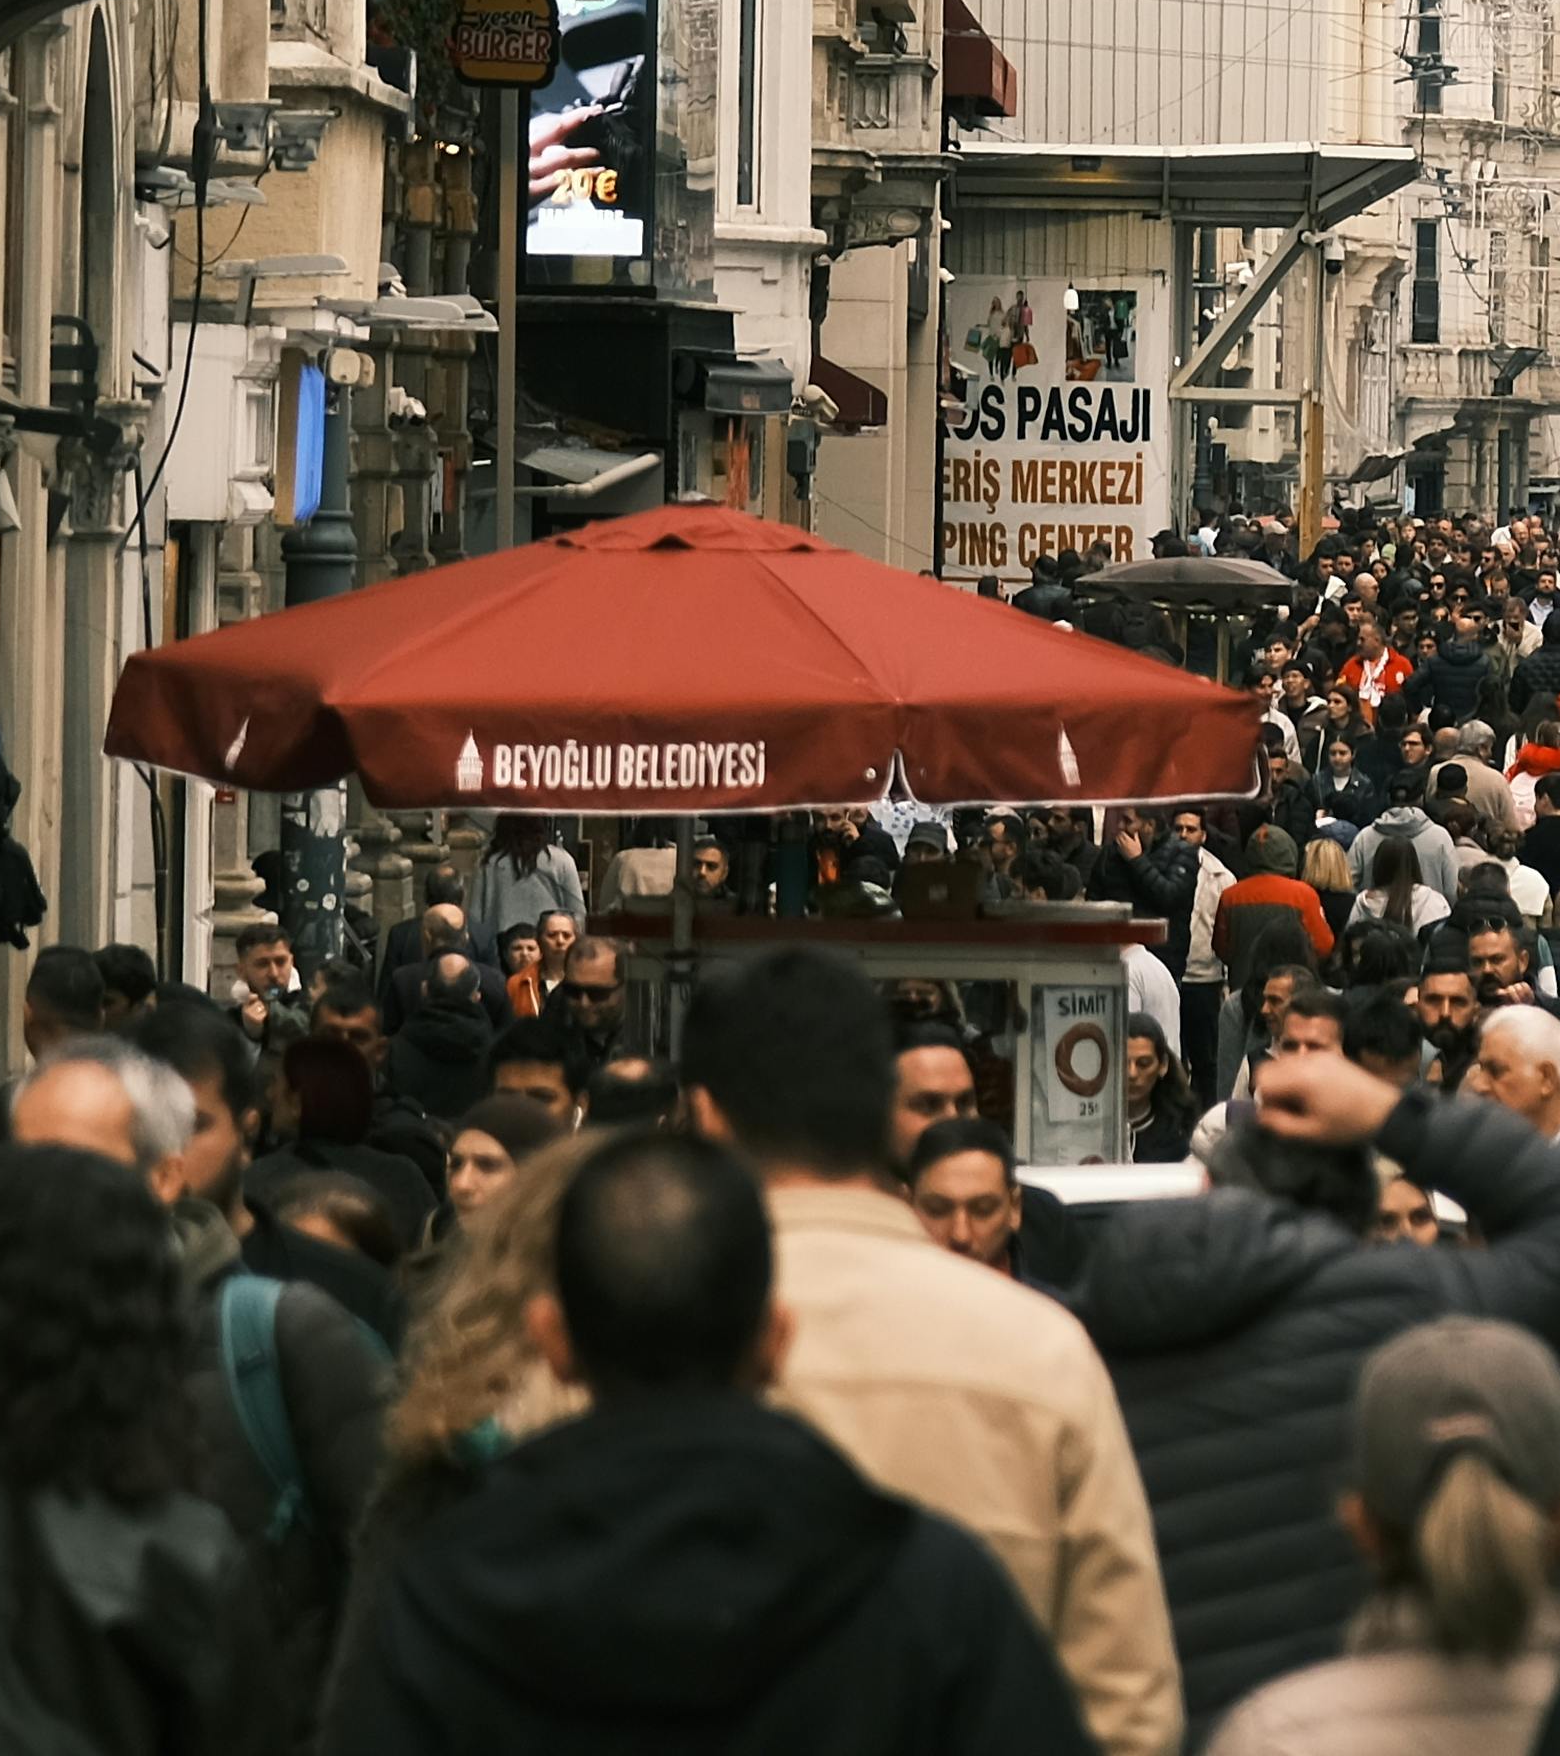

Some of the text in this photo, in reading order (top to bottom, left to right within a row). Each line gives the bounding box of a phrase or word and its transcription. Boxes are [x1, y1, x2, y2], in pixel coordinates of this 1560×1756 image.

[456, 29, 552, 63] BURGER
[1017, 386, 1151, 443] PASAJI
[1011, 452, 1143, 505] MERKEZİ
[493, 740, 766, 789] BEYOĞLU BELEDİYESİ
